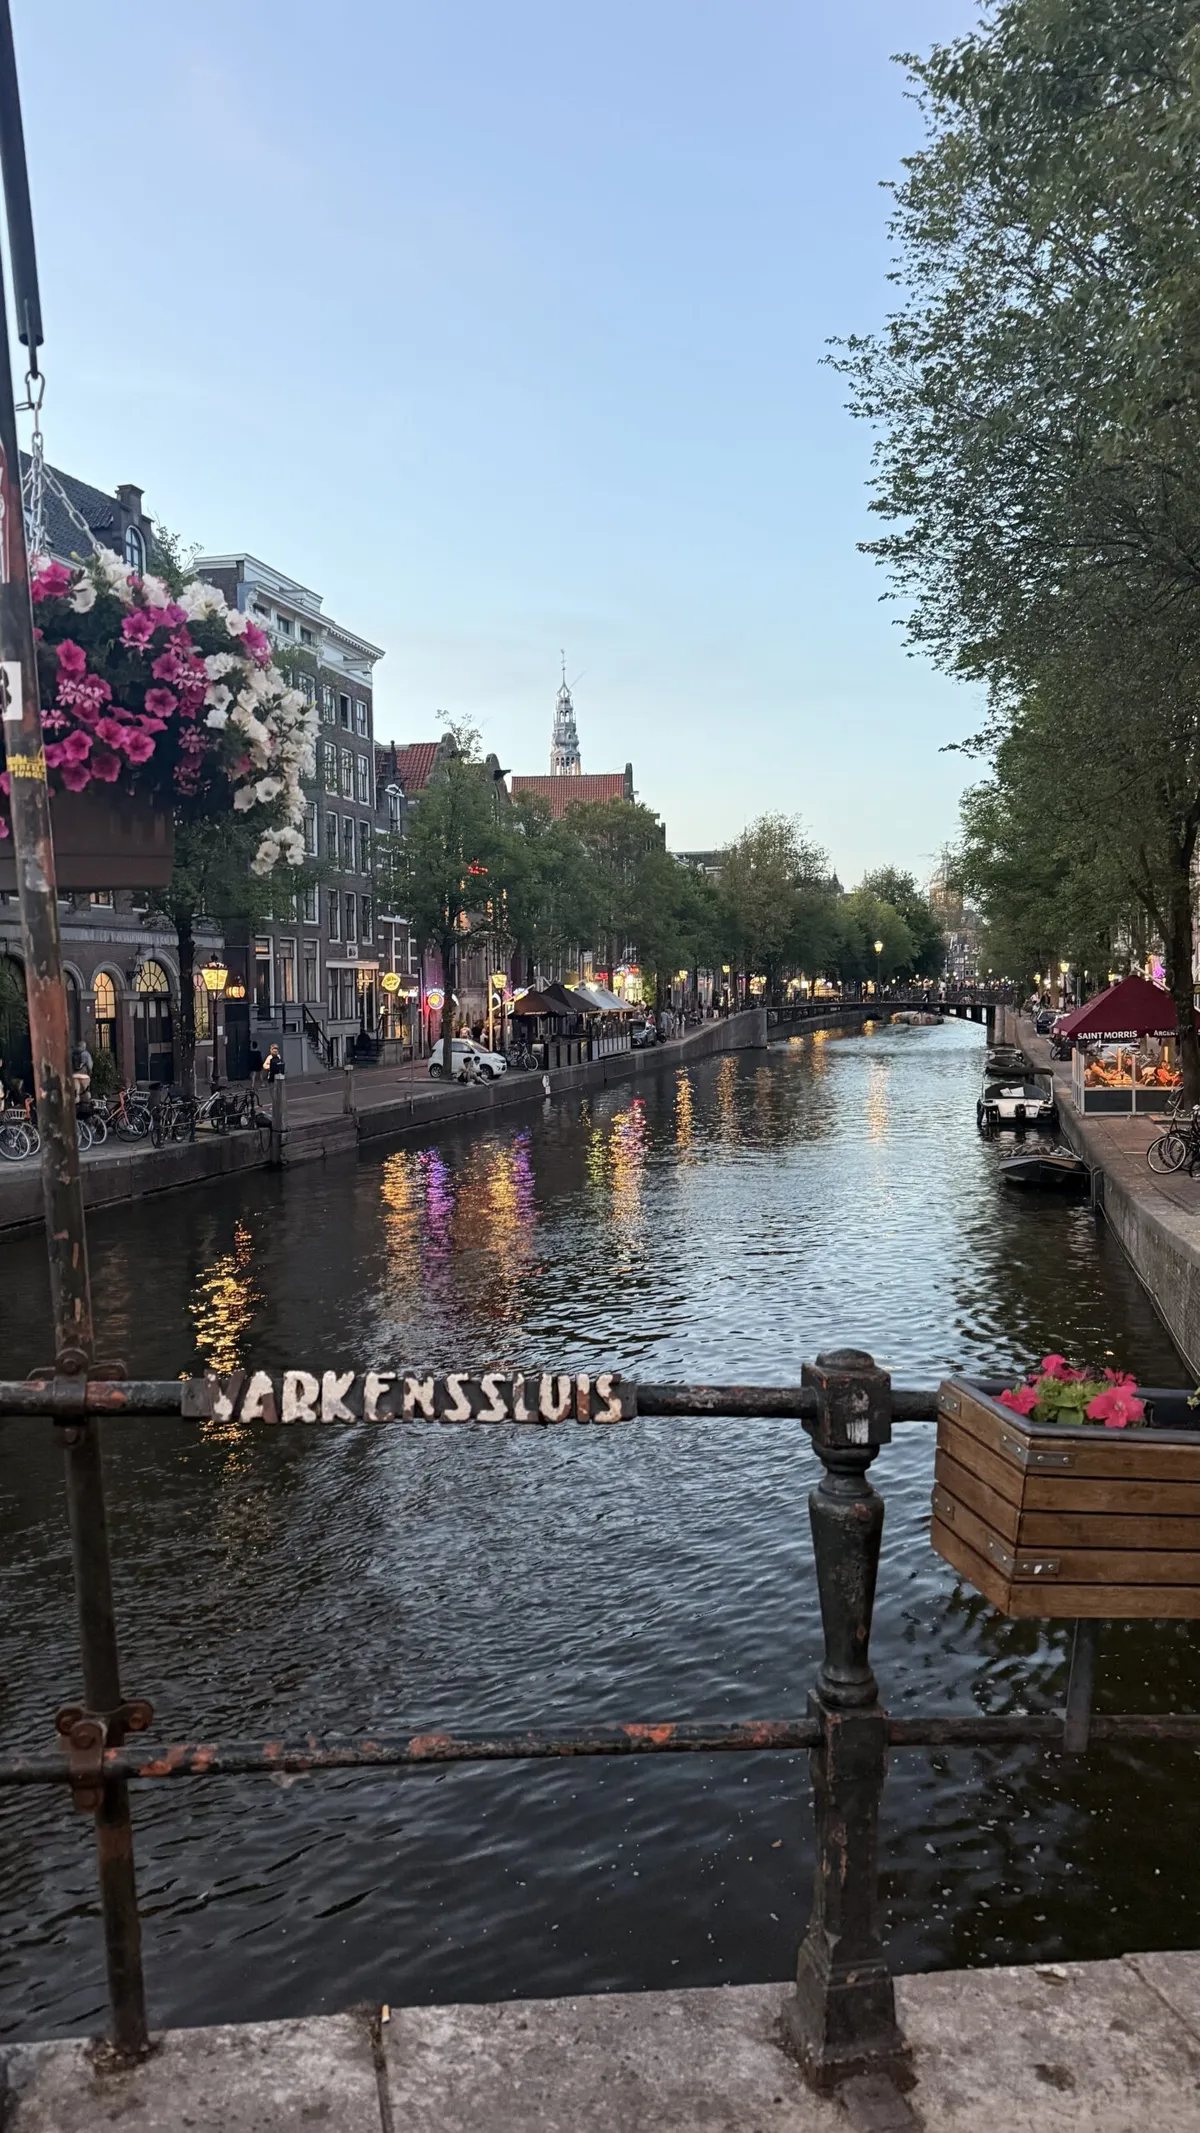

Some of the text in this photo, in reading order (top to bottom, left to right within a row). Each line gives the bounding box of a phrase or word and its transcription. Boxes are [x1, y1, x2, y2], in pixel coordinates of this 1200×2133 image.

[1077, 1030, 1138, 1040] SAINT MORRIS
[206, 1370, 623, 1424] VARKENSSLUIS
